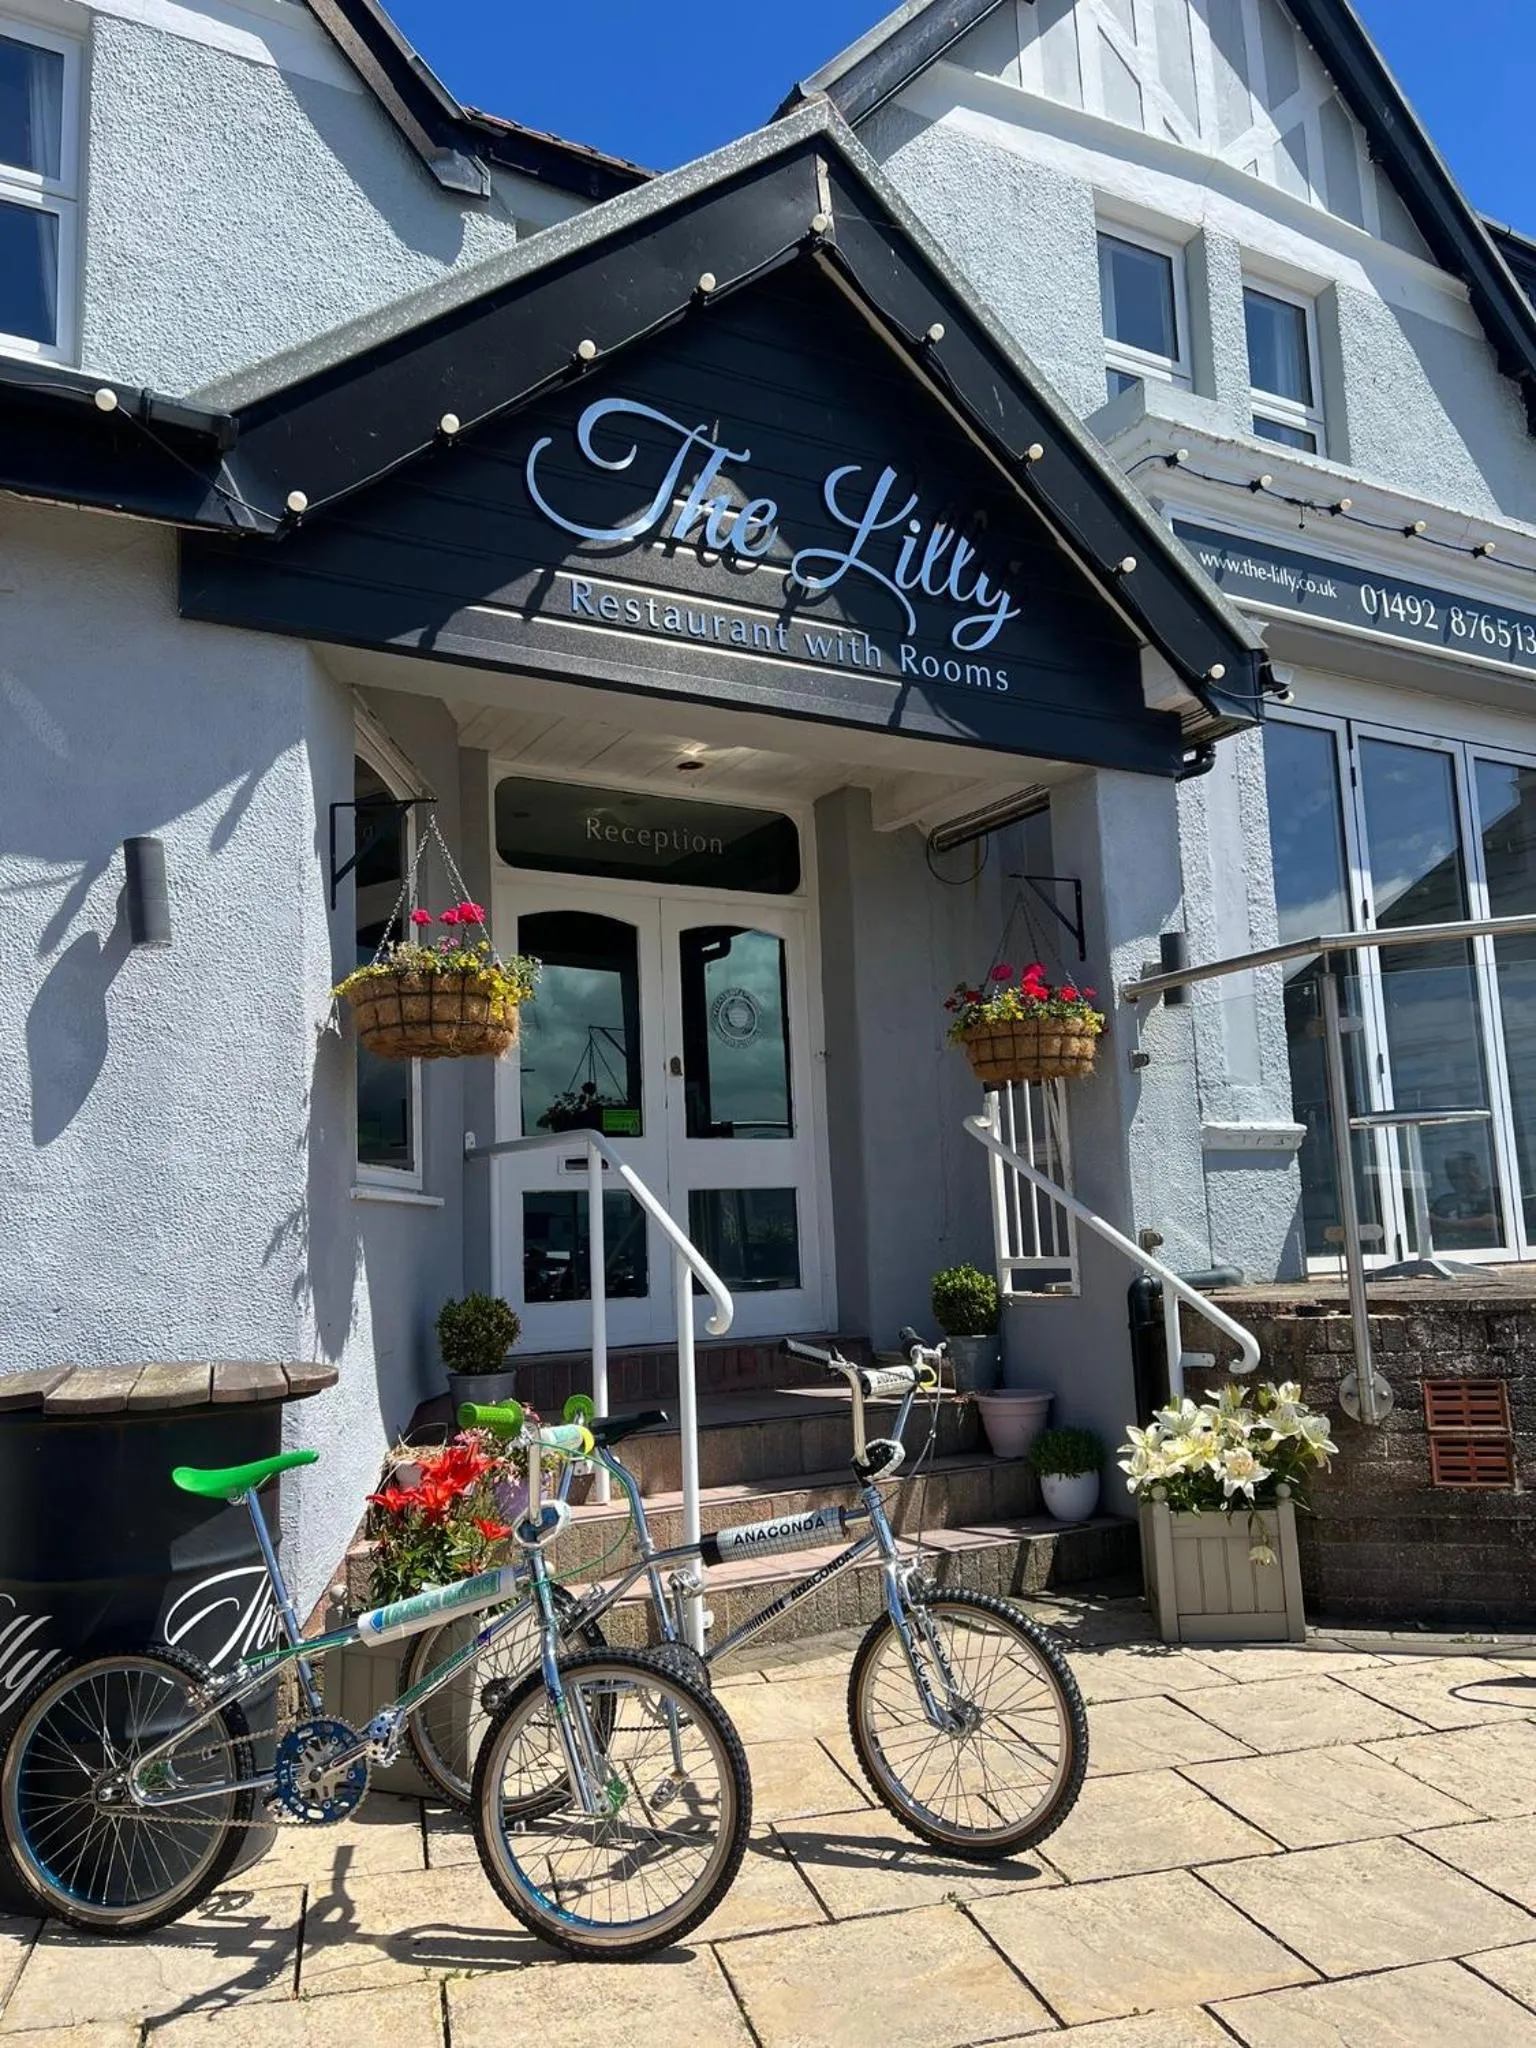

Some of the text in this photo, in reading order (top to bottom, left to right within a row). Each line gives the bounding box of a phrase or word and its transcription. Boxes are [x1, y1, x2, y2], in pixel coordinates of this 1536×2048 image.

[526, 398, 1021, 652] The Lilly
[569, 579, 1010, 693] Restaurant with Rooms
[1199, 551, 1536, 655] www.the-lilly.co.uk 01492 876513
[585, 816, 723, 854] Reception
[734, 1516, 825, 1546] ANACONDA
[790, 1551, 854, 1600] ANACONDA
